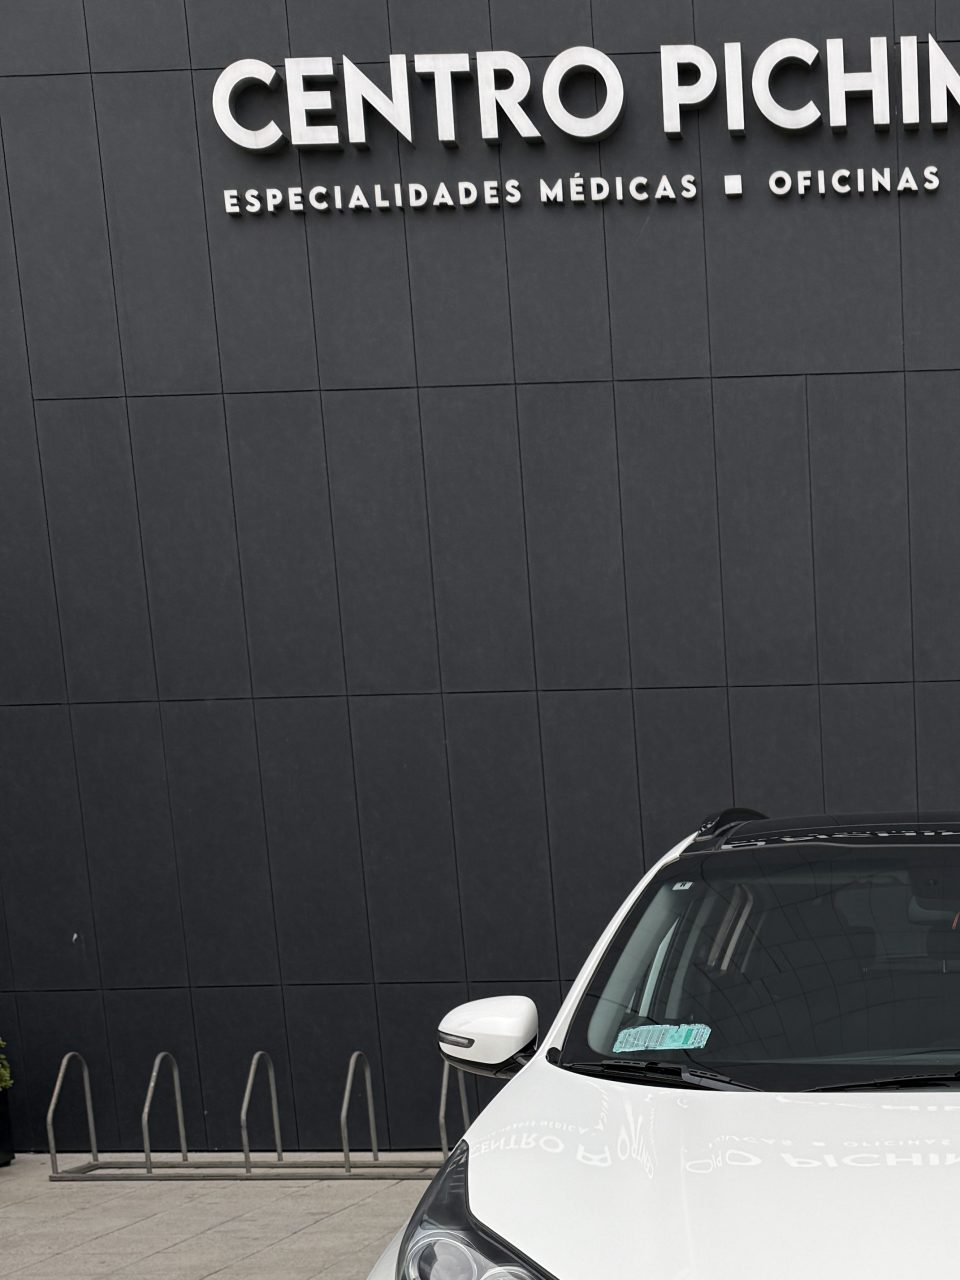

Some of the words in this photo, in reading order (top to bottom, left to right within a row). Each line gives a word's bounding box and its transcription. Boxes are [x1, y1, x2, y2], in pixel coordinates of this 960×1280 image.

[211, 45, 625, 150] CENTRO
[223, 178, 522, 213] ESPECIALIDADES
[539, 172, 697, 203] MÉDICAS
[768, 165, 940, 196] OFICINAS
